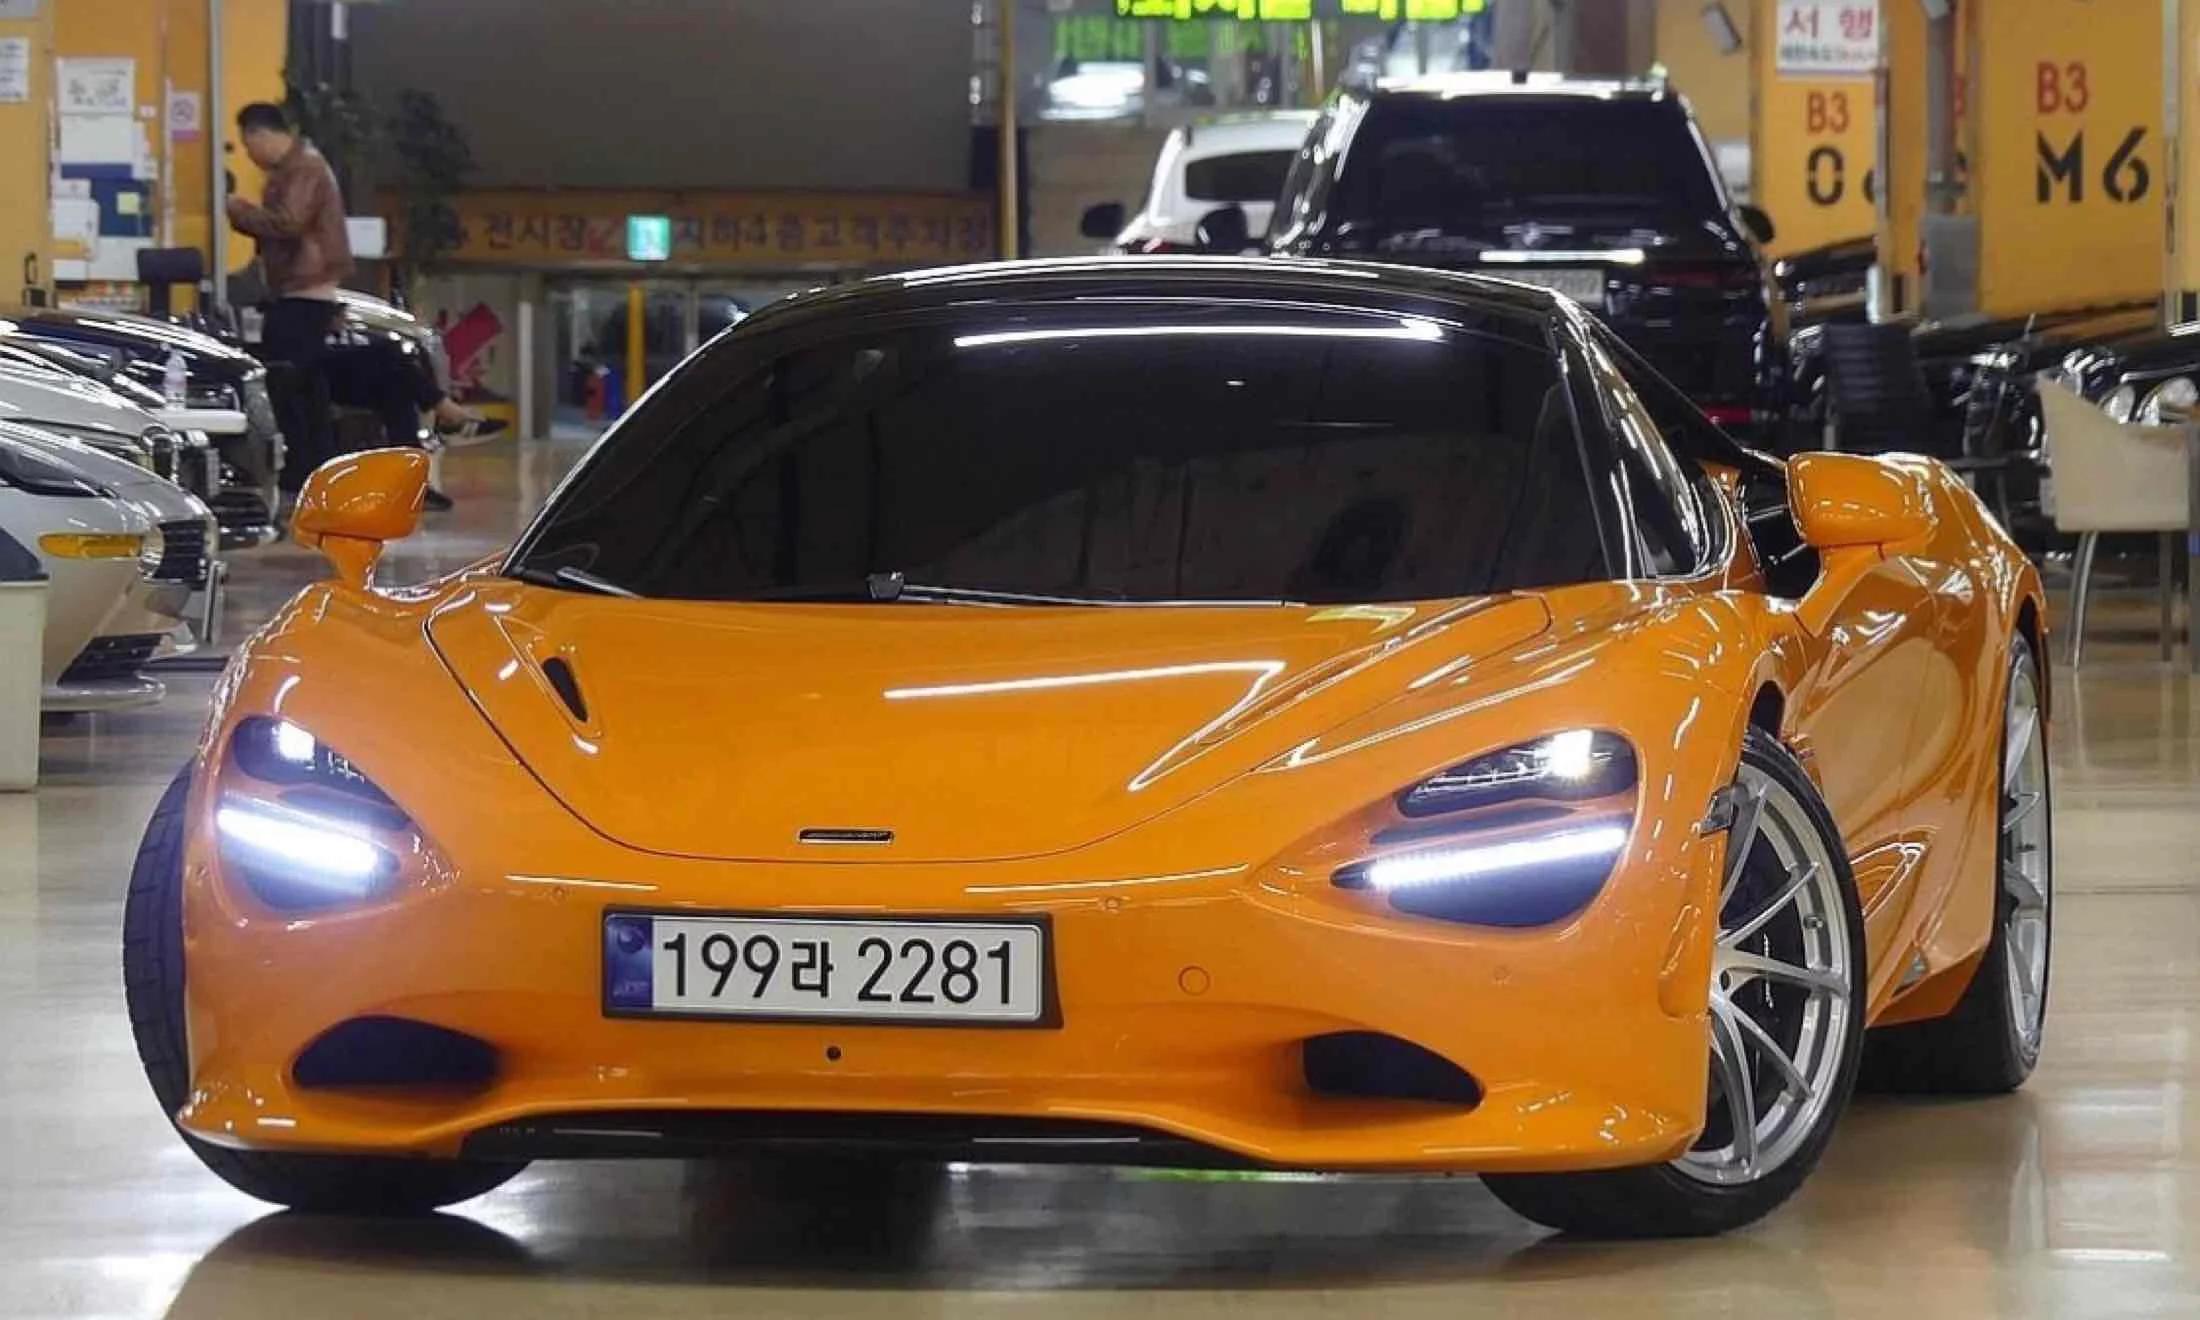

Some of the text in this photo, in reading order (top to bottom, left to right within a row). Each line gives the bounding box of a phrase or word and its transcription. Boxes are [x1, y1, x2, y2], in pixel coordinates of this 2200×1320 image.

[1807, 91, 1849, 134] B3
[2036, 62, 2088, 114] B3
[663, 932, 1012, 1005] 199라 2281
